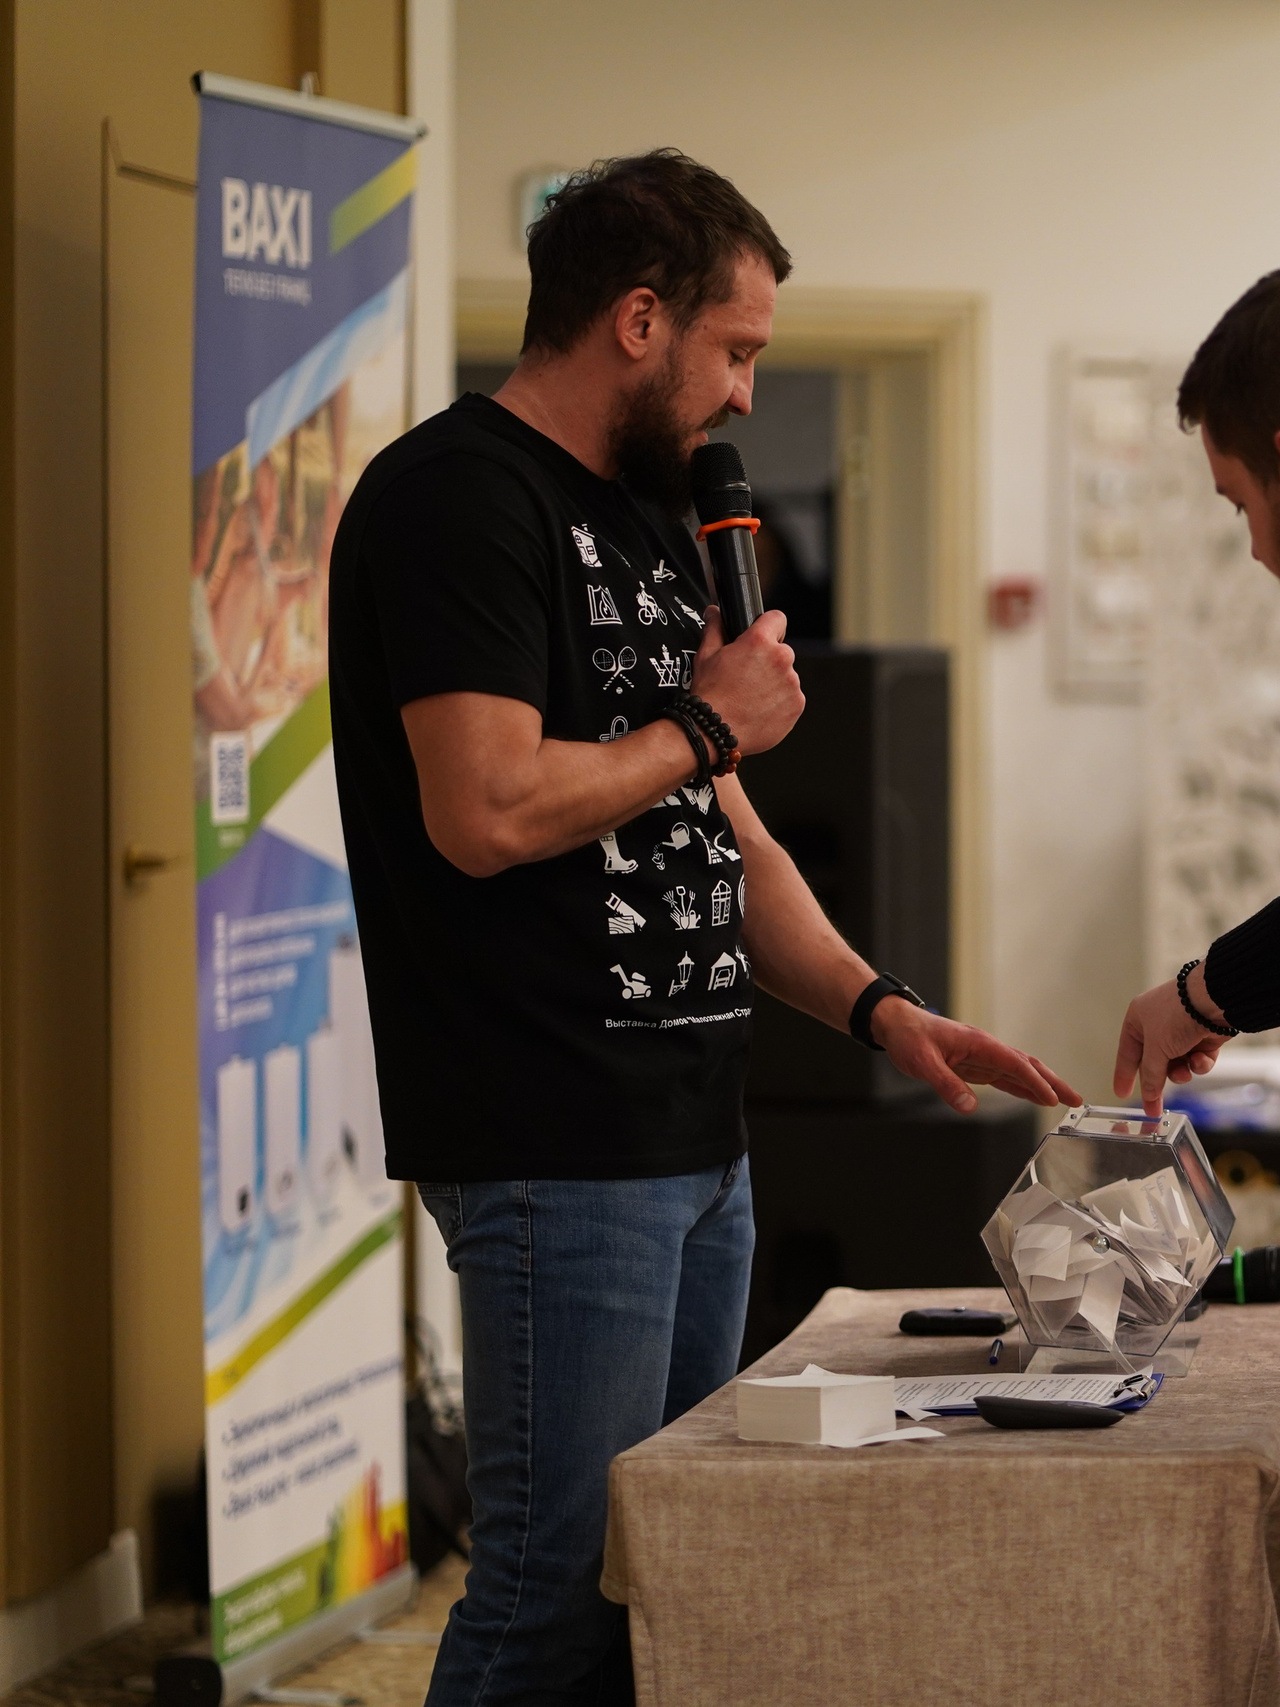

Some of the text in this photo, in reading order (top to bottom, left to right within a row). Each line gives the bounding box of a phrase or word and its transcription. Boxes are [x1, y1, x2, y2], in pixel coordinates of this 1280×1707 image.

[221, 176, 312, 269] BAXI
[605, 1018, 657, 1028] Выставка
[659, 1016, 689, 1029] Домов
